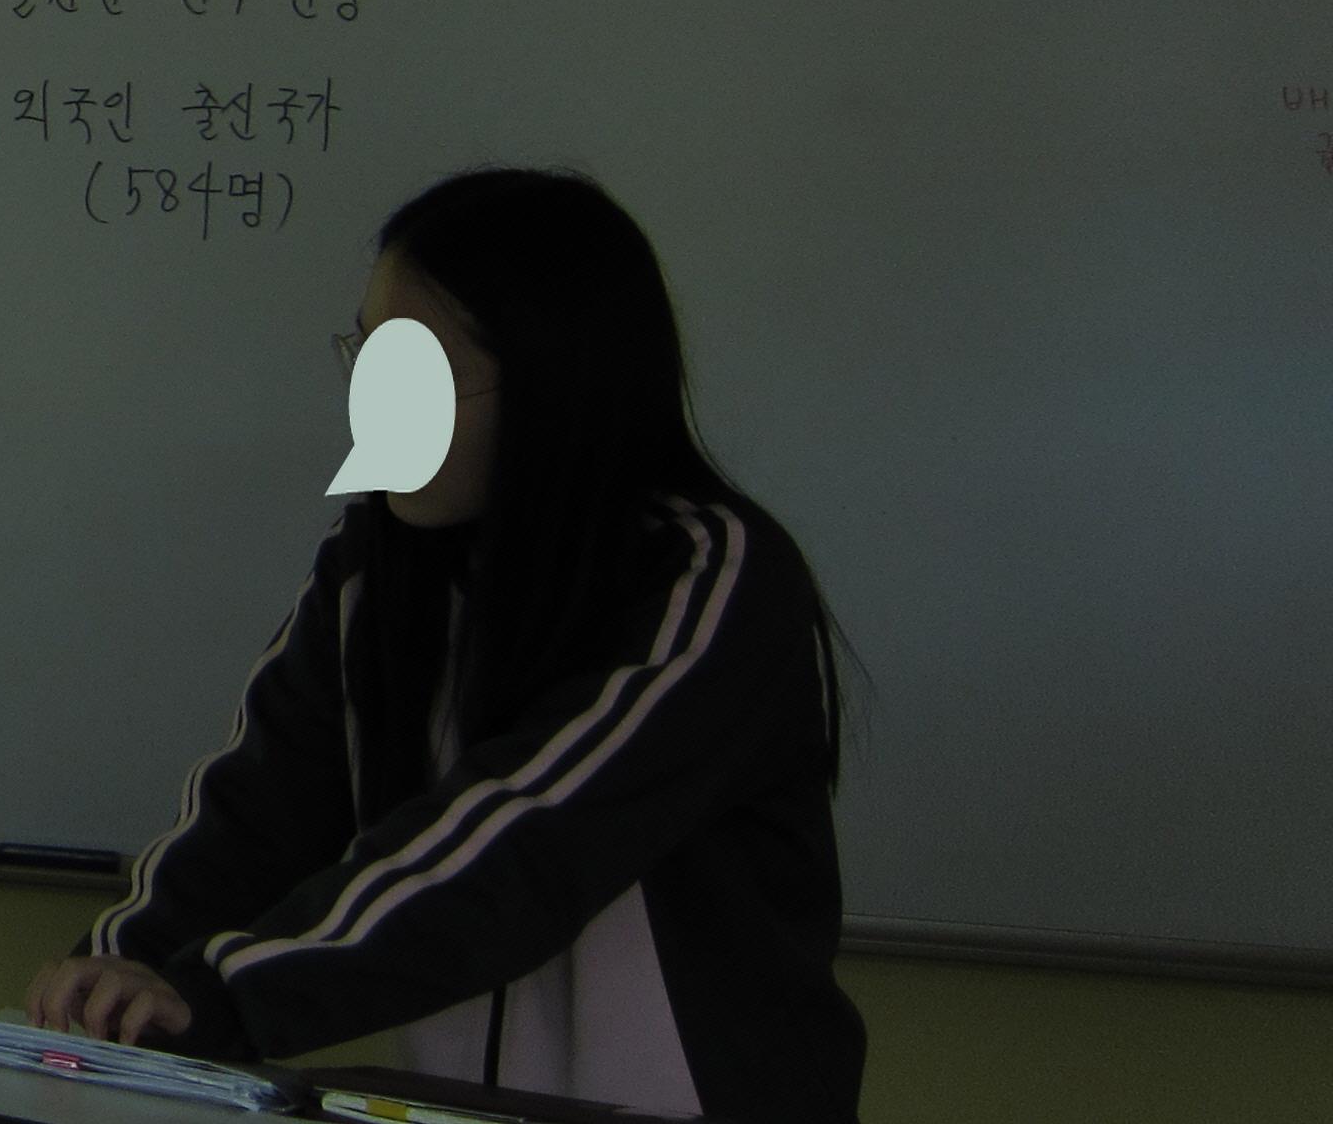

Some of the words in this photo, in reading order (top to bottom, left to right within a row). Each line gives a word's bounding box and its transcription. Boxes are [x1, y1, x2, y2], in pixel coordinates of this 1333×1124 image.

[14, 80, 133, 145] 외국인
[181, 78, 342, 152] 출신국가
[85, 162, 295, 242] (584명)
